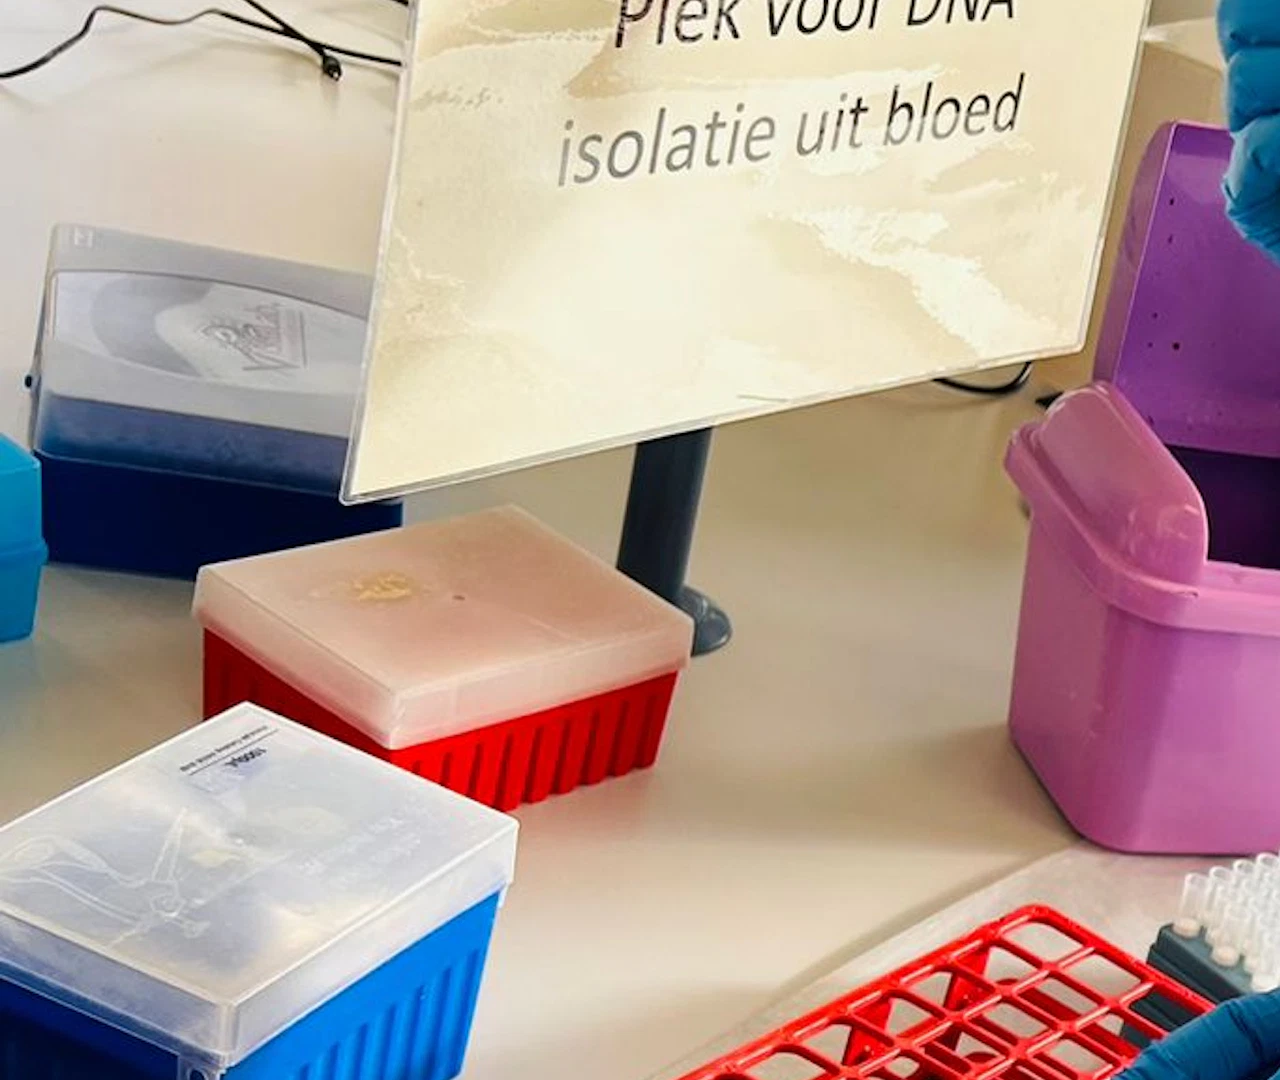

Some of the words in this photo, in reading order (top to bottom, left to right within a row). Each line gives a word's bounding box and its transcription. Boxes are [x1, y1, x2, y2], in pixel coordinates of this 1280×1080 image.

[615, 0, 740, 48] Plek
[767, 0, 879, 36] voor
[558, 103, 776, 187] isolatie
[796, 92, 869, 156] uit
[883, 72, 1026, 146] bloed
